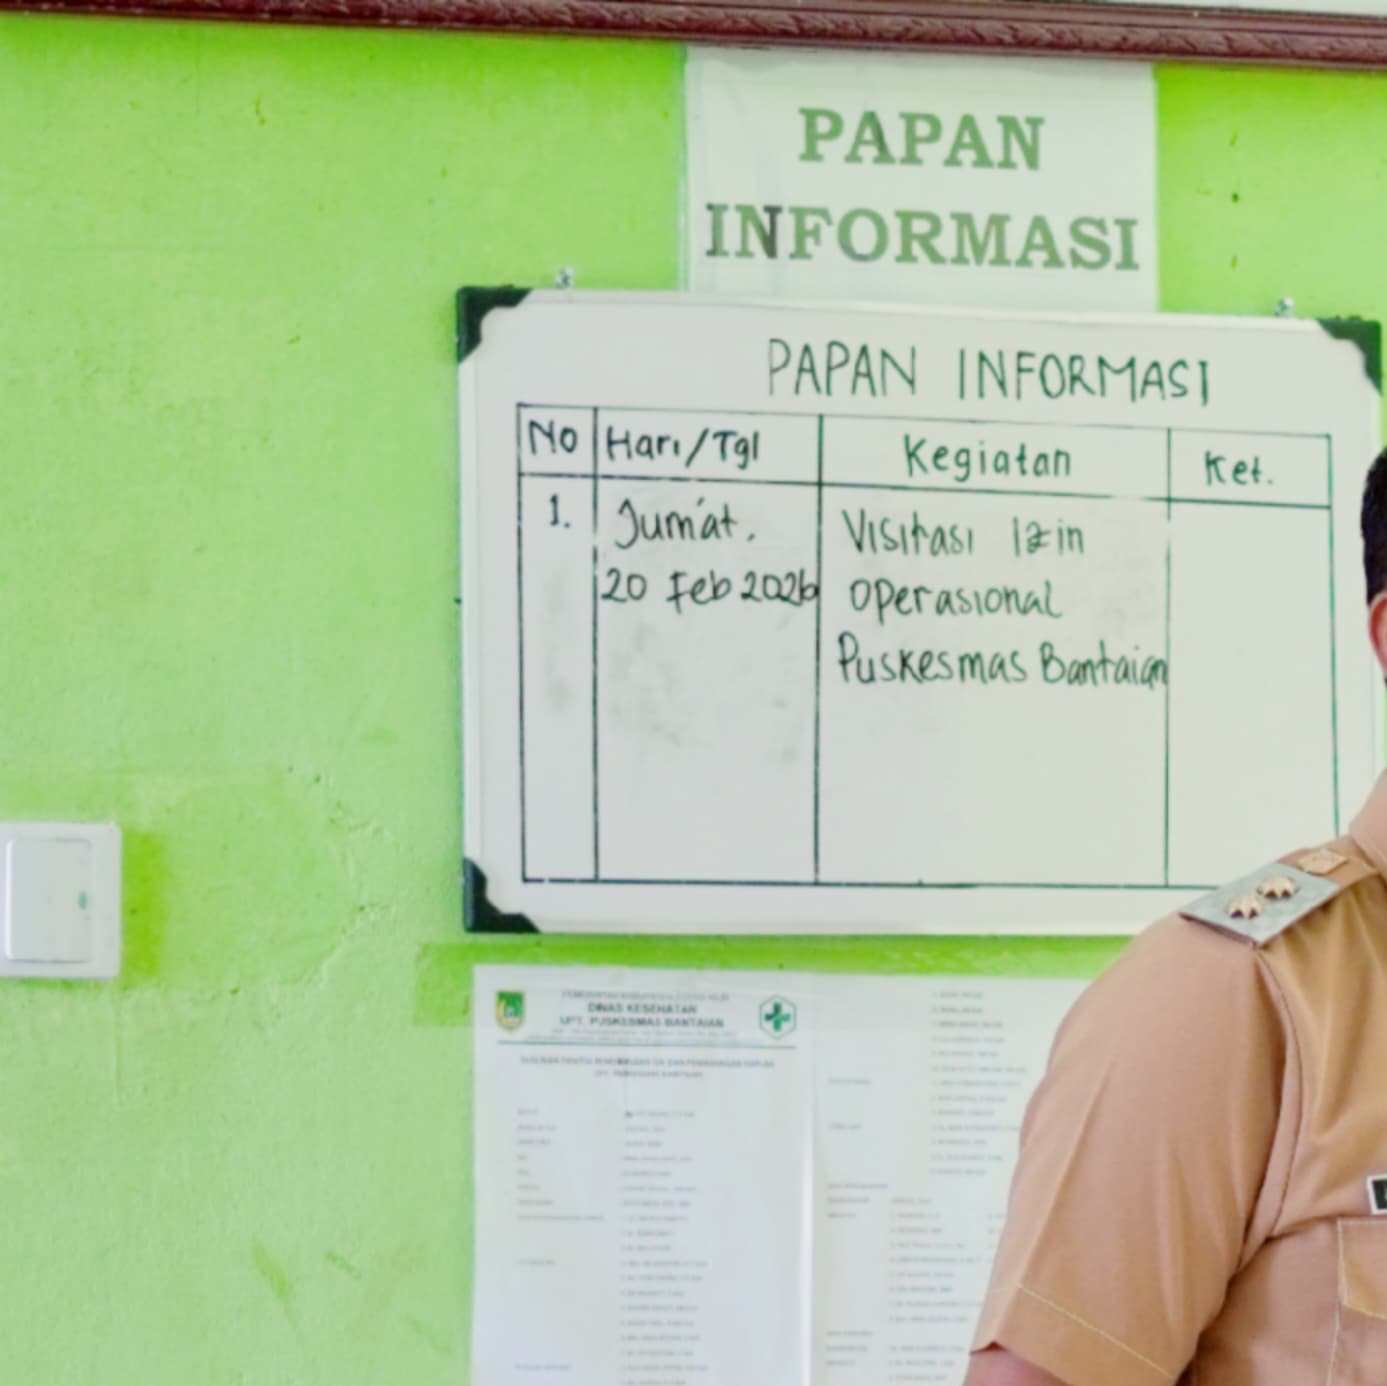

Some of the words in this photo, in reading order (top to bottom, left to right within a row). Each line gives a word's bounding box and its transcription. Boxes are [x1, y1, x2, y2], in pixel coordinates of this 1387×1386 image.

[798, 107, 1045, 171] PAPAN
[706, 202, 1140, 271] INFORMASI
[768, 337, 916, 397] PAPAN
[958, 348, 1208, 407] INFORMASI
[529, 418, 577, 455] No
[903, 433, 1072, 483] Kegiatan
[1205, 449, 1275, 487] Ket.
[841, 508, 975, 558] Visitasi
[600, 567, 647, 602] 20
[665, 569, 733, 615] Feb
[740, 567, 821, 607] 2026
[837, 631, 1028, 685] Puskesmas
[1039, 639, 1168, 687] Bantaian
[626, 1003, 698, 1015] KESEHATAN
